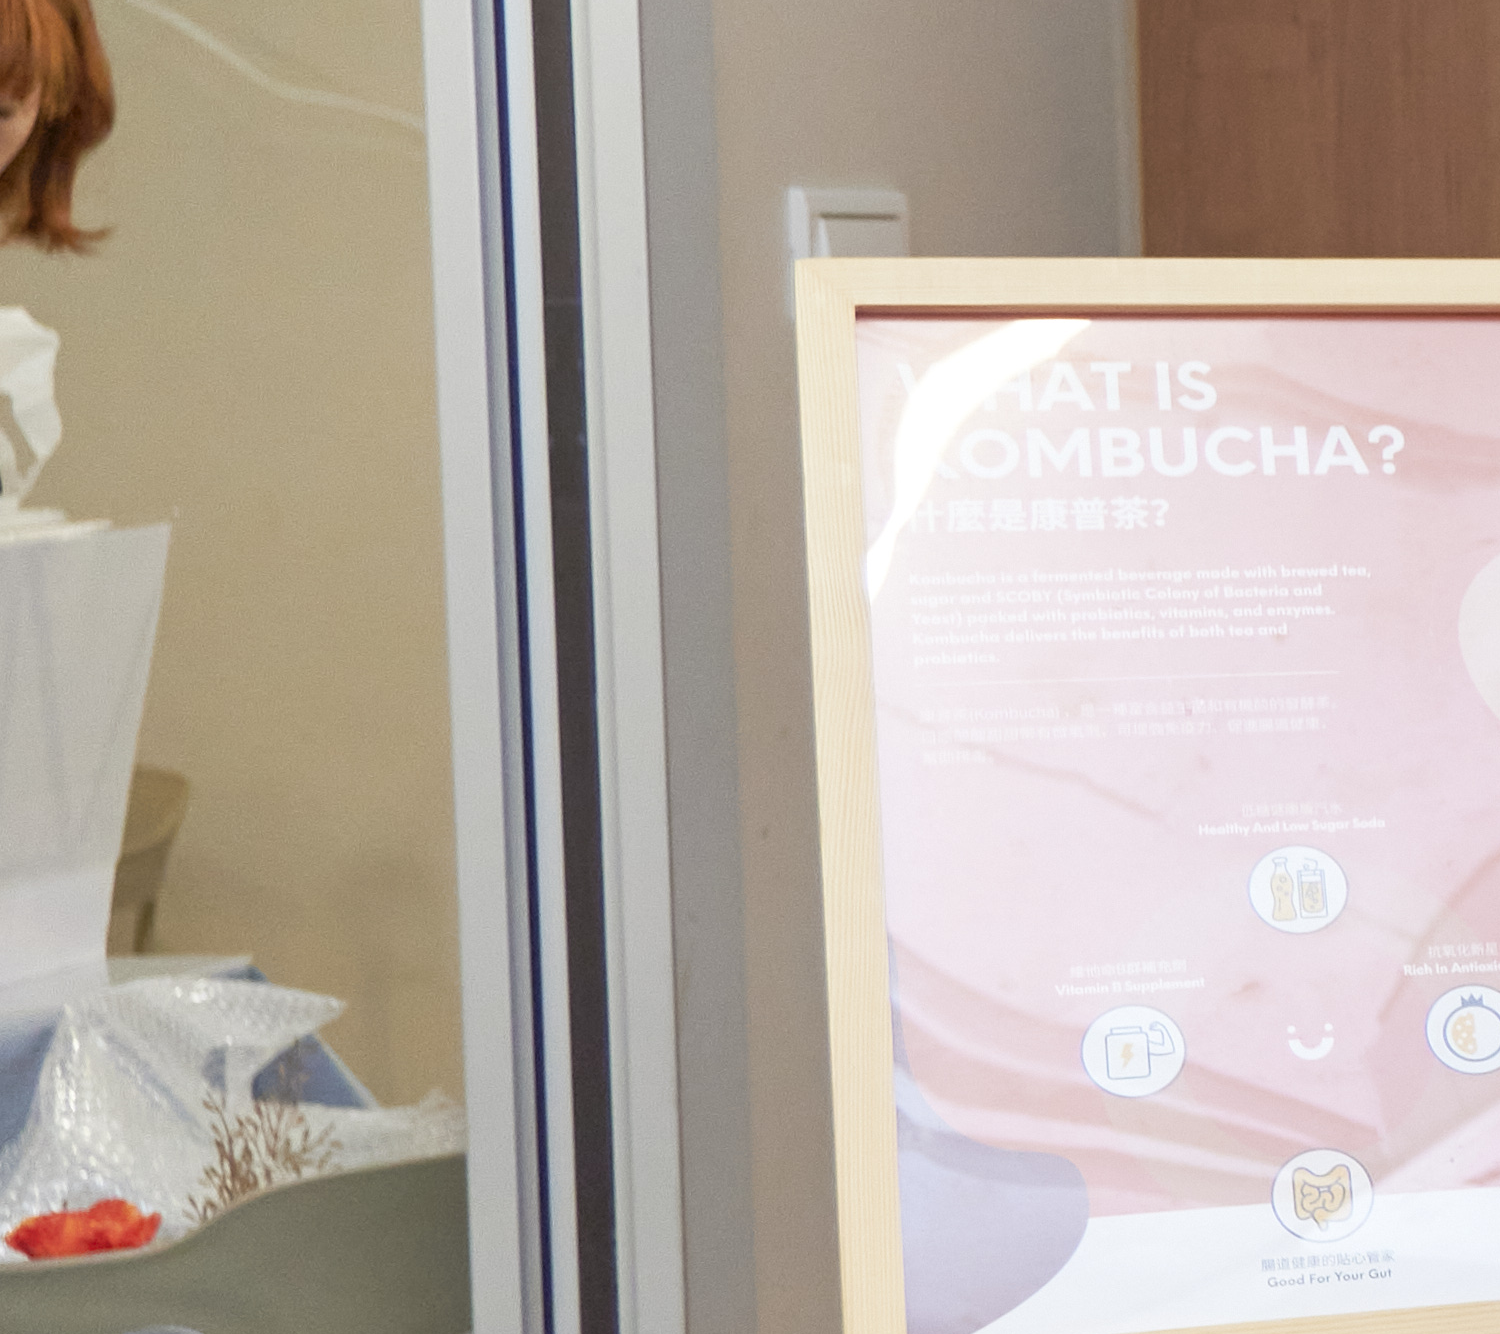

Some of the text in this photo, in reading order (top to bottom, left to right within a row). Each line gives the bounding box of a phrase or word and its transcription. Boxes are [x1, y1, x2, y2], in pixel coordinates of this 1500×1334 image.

[1156, 361, 1217, 411] IS
[1198, 816, 1386, 837] Healthy And Low Sugar Soda
[1403, 962, 1432, 976] Rich
[1436, 962, 1448, 974] In
[1055, 980, 1109, 997] Vitamin
[1124, 975, 1205, 993] Supplement
[1268, 1268, 1392, 1288] Good For Your Gut
